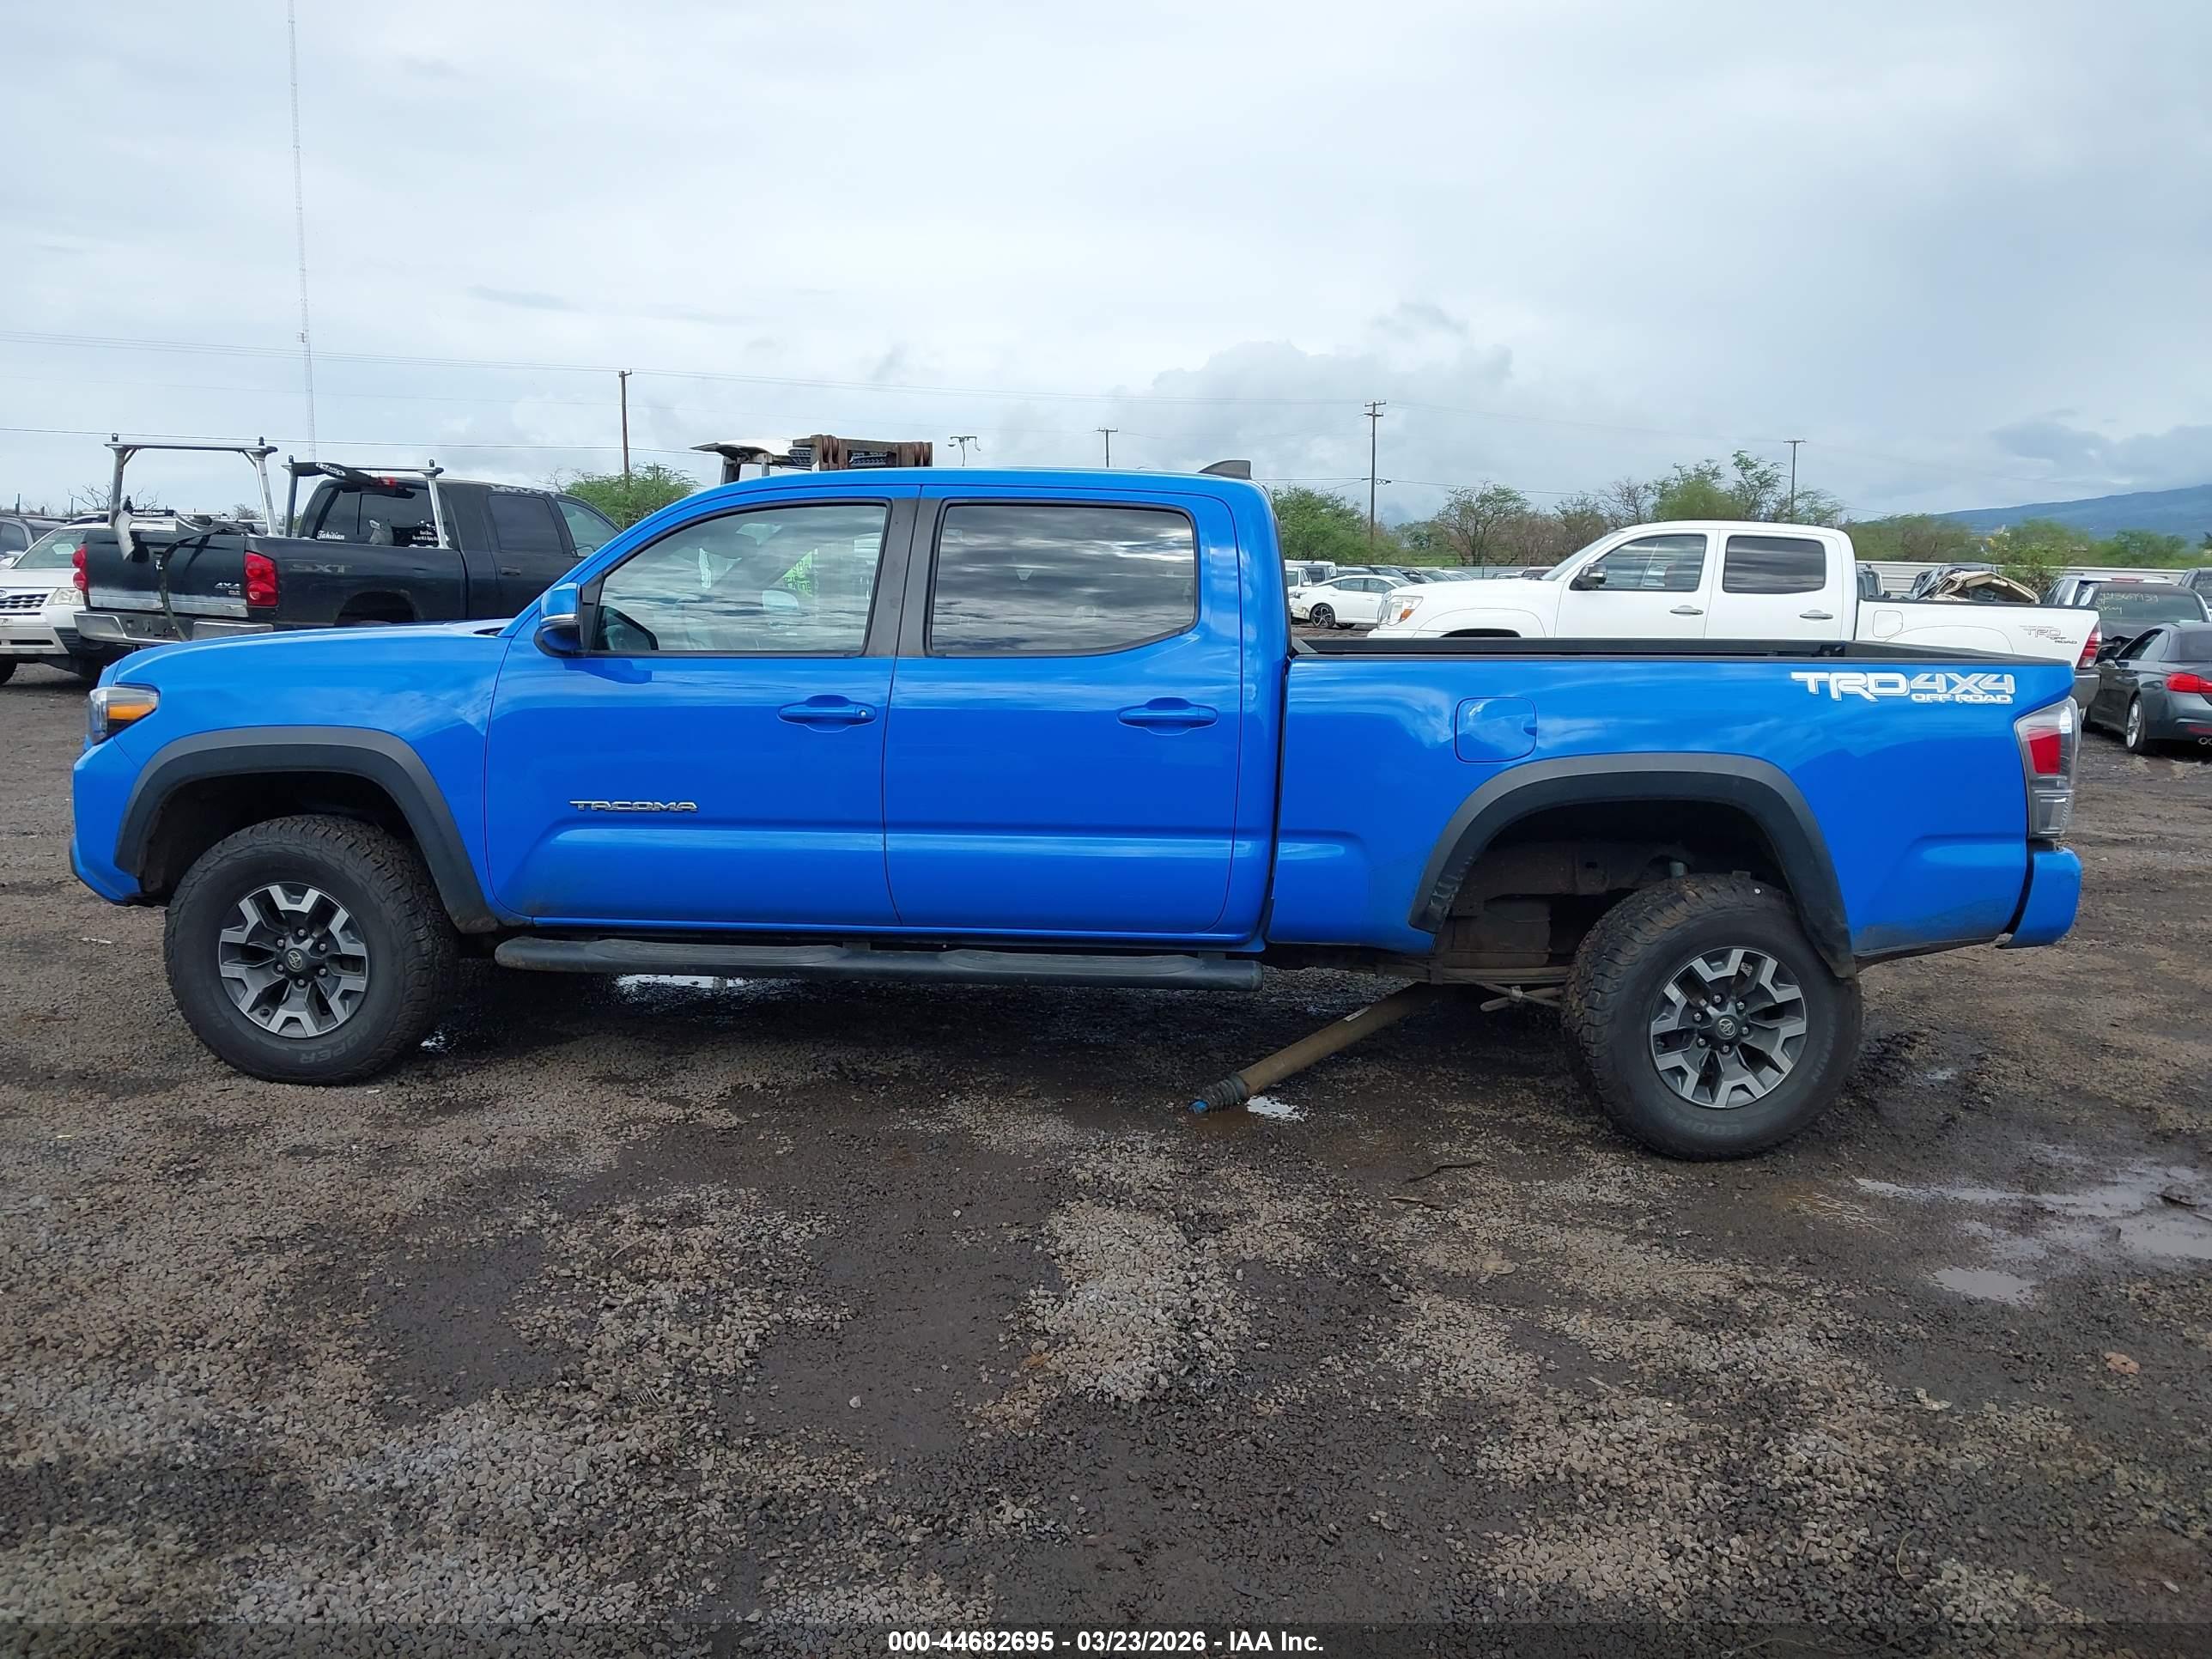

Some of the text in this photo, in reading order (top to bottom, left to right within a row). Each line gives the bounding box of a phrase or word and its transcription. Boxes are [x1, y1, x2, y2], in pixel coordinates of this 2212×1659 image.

[1790, 672, 2015, 702] TRD 4X4
[1911, 693, 2014, 704] OFF ROAD
[569, 800, 698, 811] TACOMA
